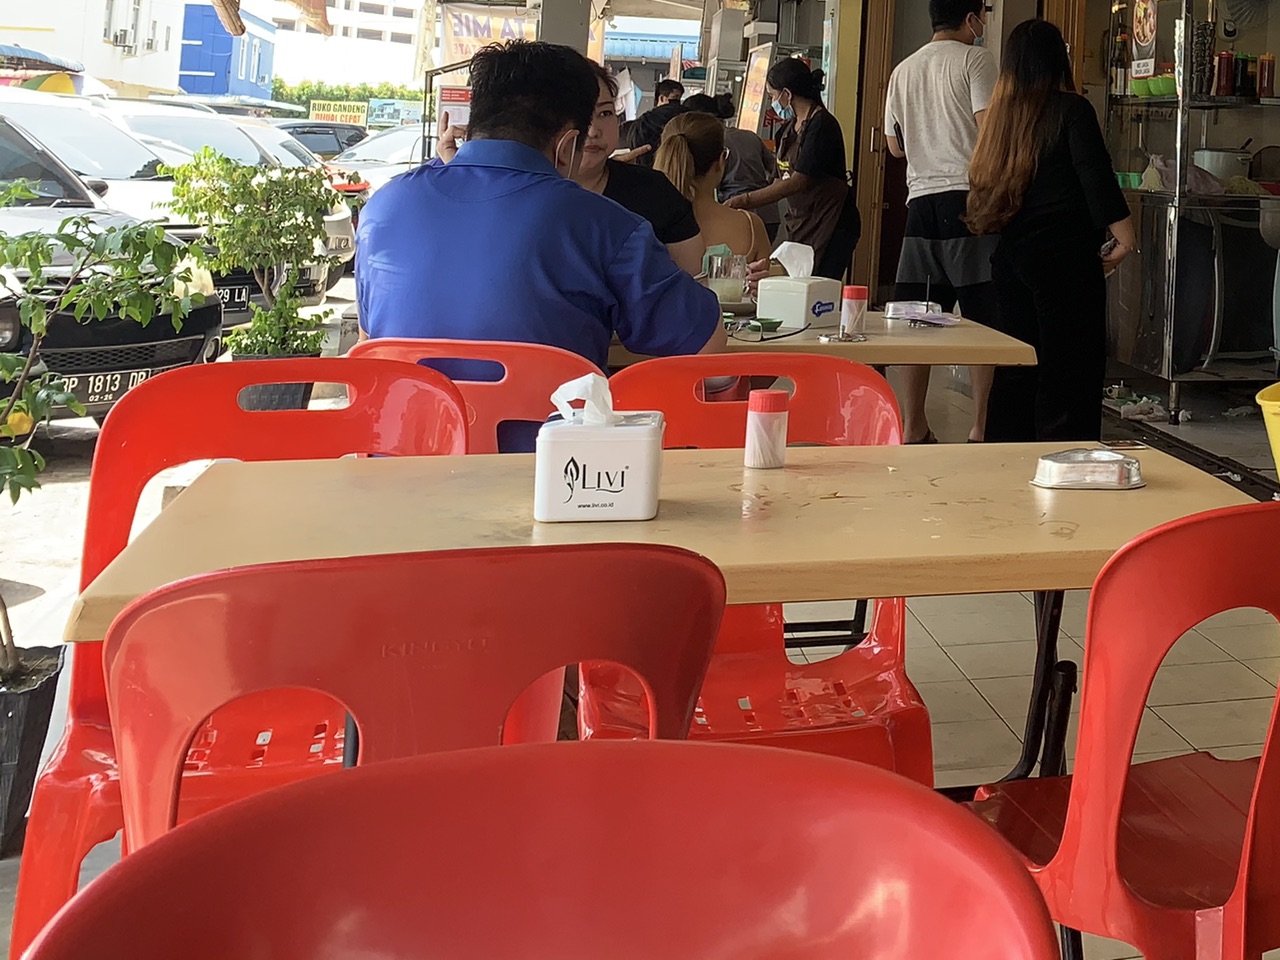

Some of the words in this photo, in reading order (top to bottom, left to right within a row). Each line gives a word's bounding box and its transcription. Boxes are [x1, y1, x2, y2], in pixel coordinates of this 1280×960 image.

[312, 102, 332, 112] RUKO
[332, 103, 366, 114] GANDENG
[235, 288, 246, 302] LA
[88, 374, 121, 393] 1813
